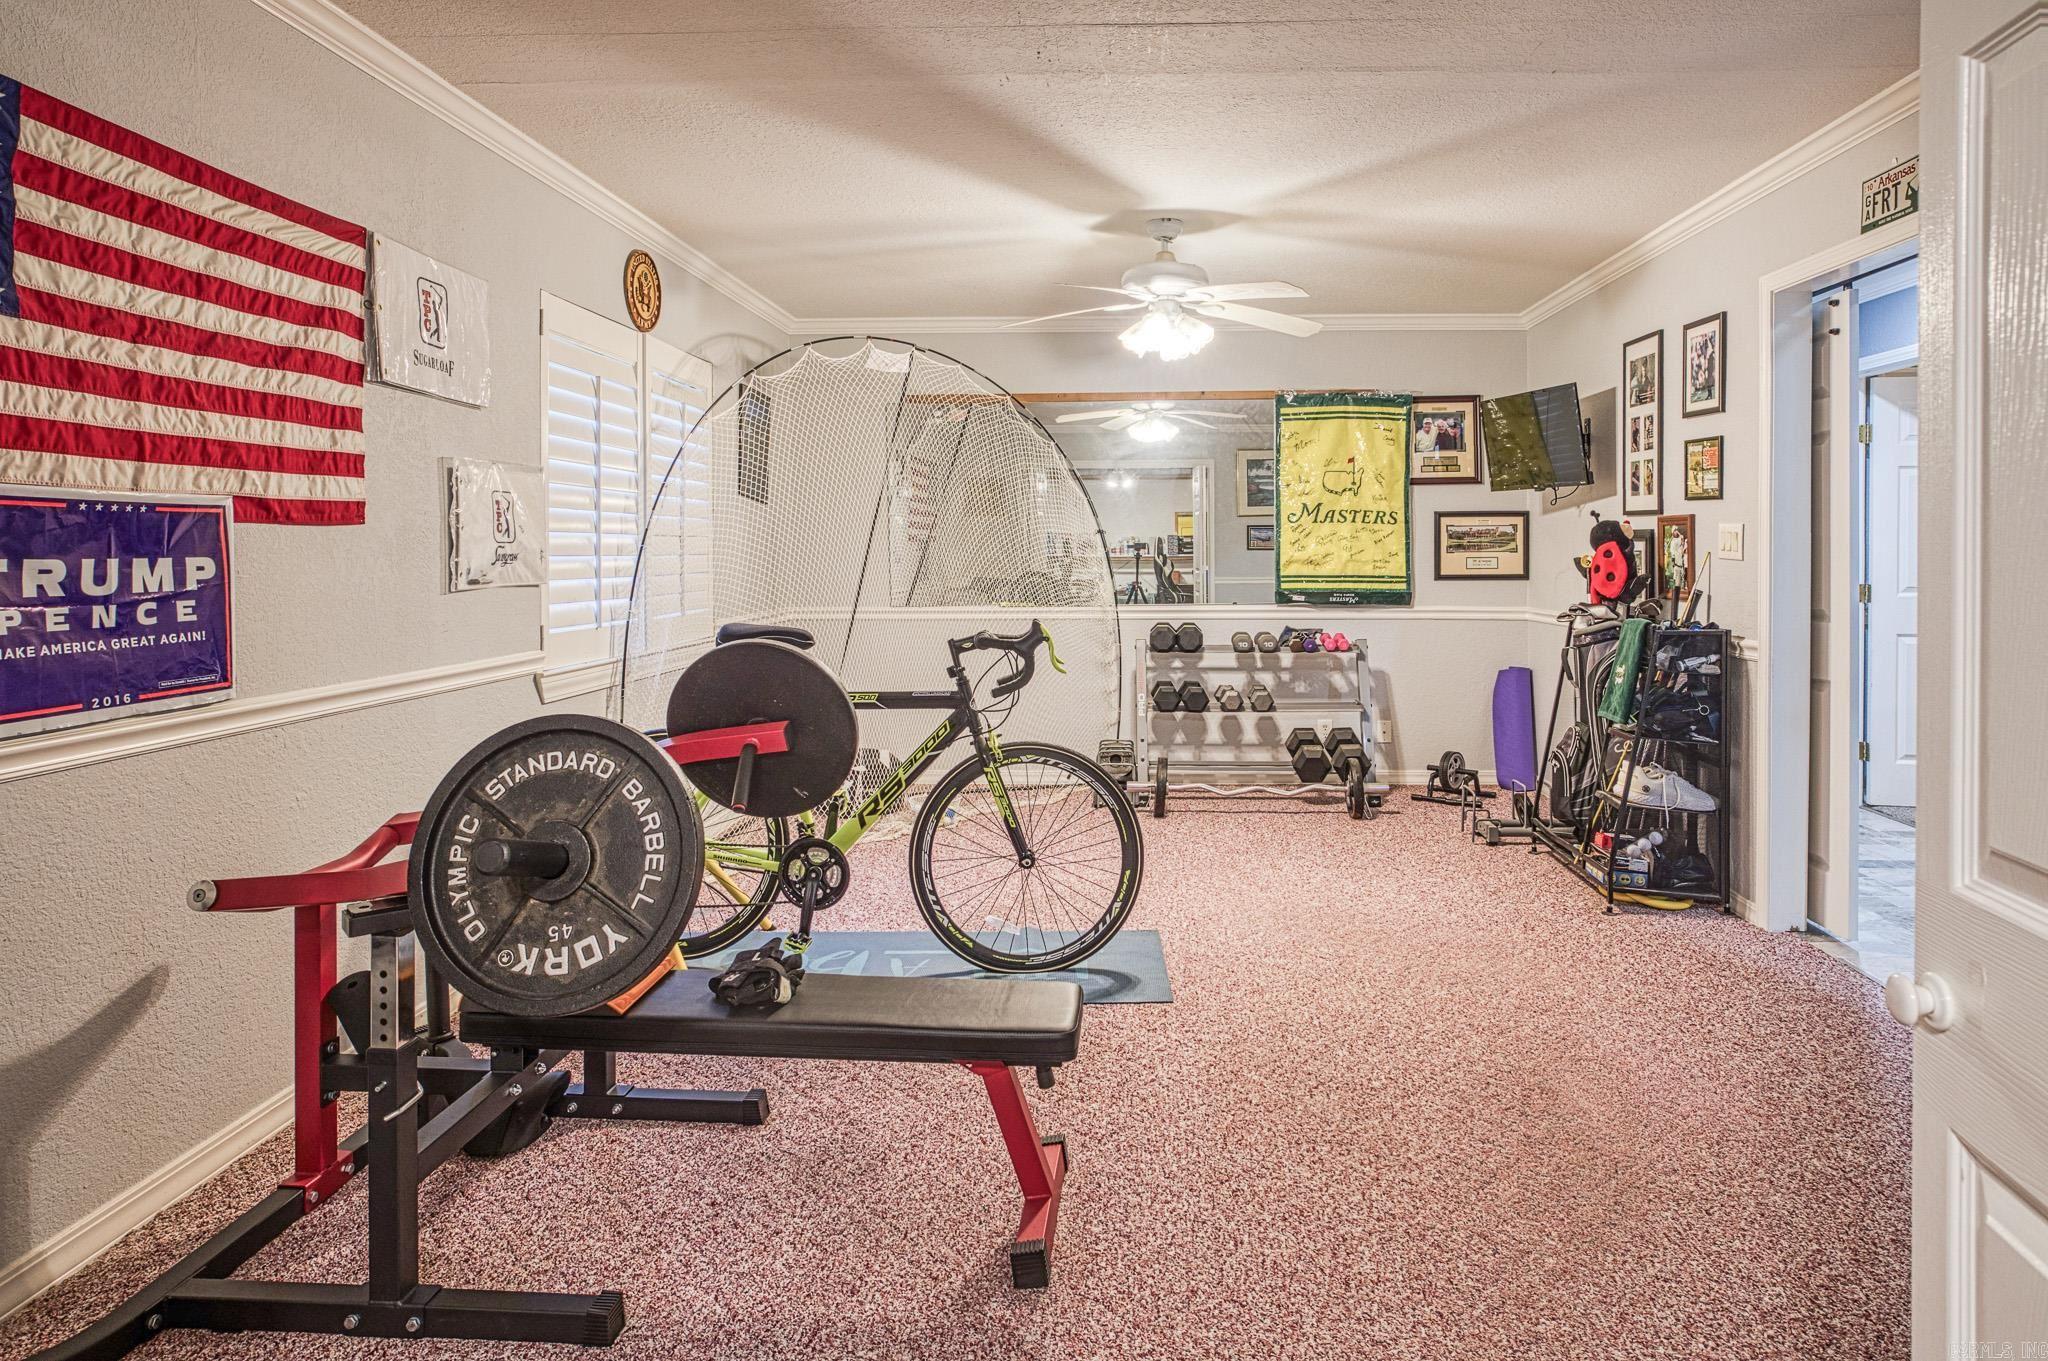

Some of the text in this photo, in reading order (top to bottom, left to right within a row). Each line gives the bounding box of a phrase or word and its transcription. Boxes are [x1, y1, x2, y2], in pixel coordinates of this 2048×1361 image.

[1877, 163, 1917, 189] Arkansas
[1871, 181, 1902, 219] FRT
[421, 289, 432, 333] TPC
[413, 348, 455, 377] SUGARLOAF
[0, 556, 217, 598] RUMP
[0, 599, 198, 636] PENCE
[0, 630, 207, 660] AKE AMERICA GREAT AGAIN!
[92, 693, 131, 709] 2016
[484, 750, 617, 801] STANDARD
[621, 778, 666, 911] BARBELL
[447, 814, 486, 942] OLYMPIC
[548, 922, 574, 942] 45
